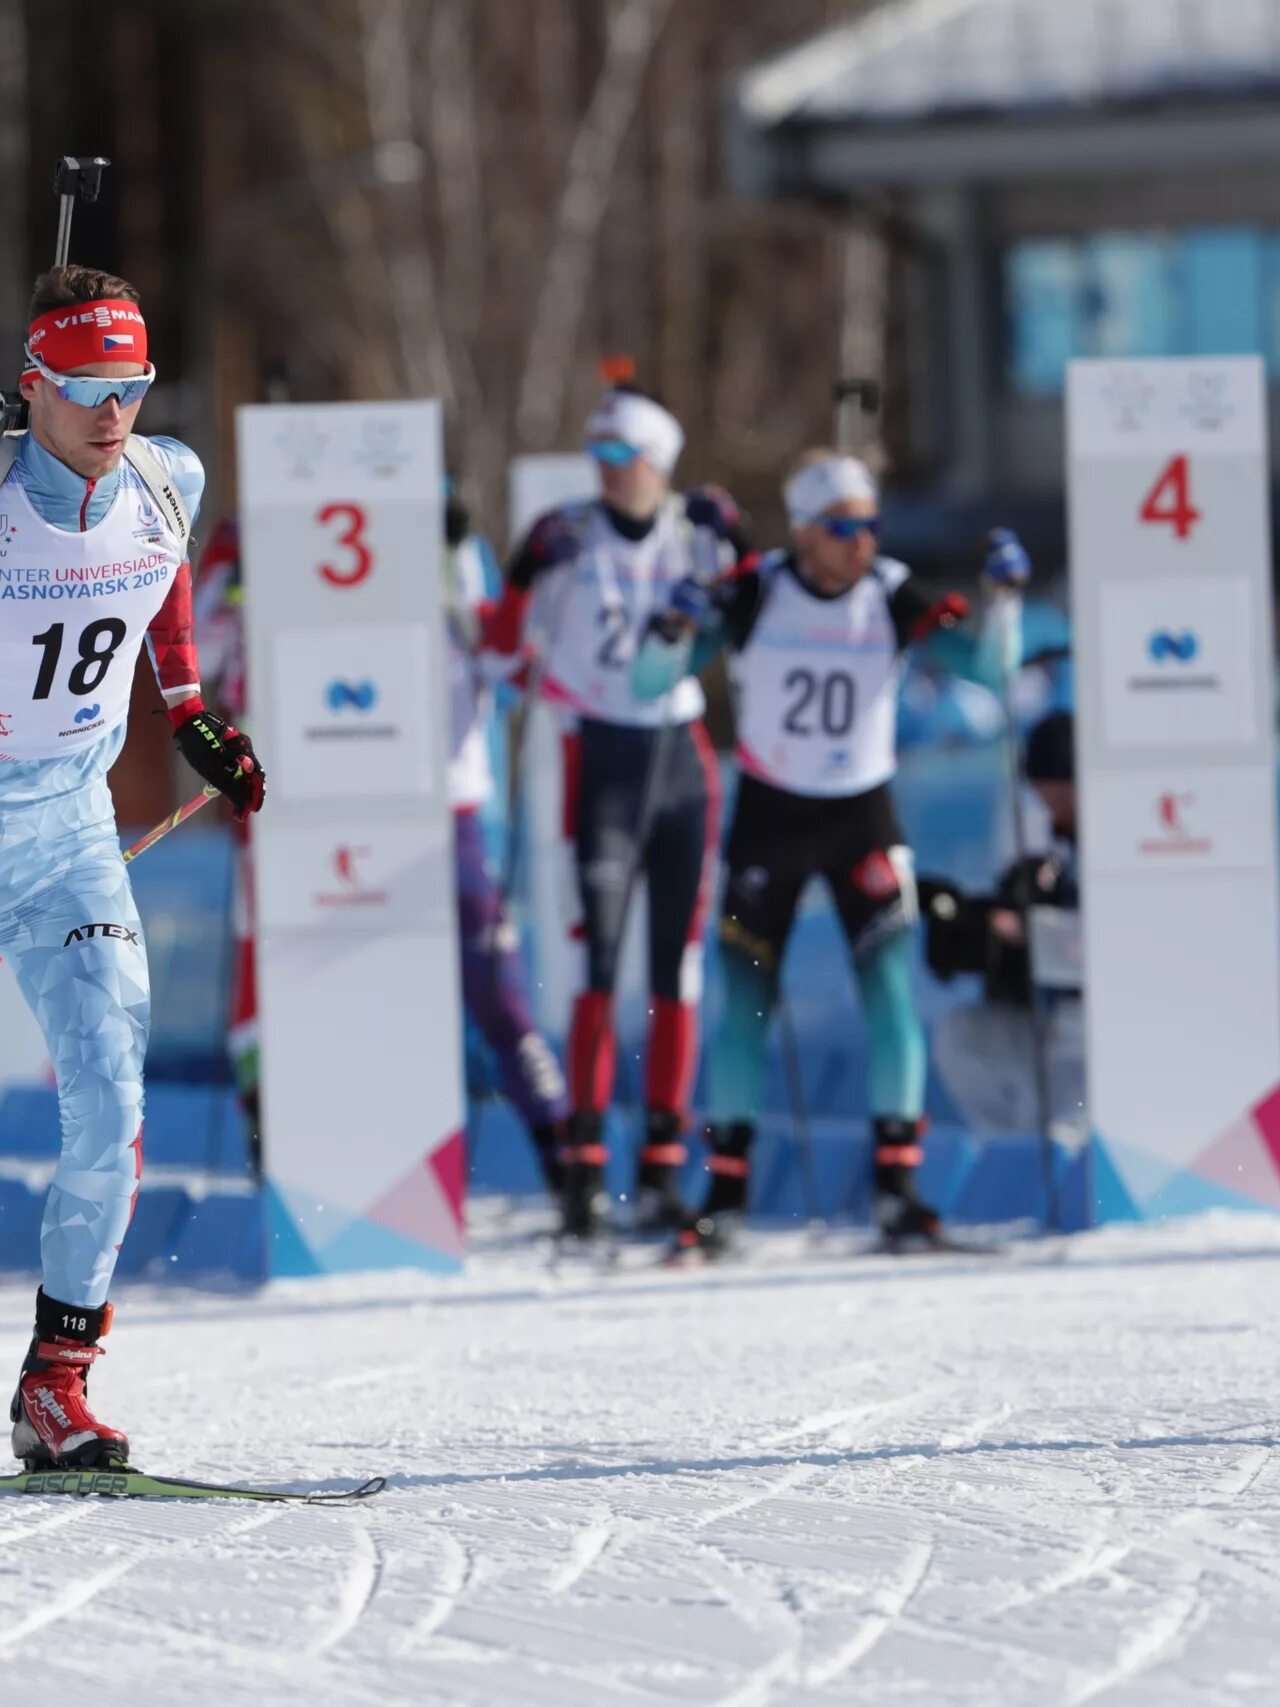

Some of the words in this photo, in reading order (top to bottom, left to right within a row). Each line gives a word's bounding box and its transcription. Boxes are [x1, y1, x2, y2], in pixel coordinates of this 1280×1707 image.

[1138, 452, 1200, 541] 4
[316, 501, 375, 588] 3
[55, 552, 168, 582] UNIVERSIADE
[133, 565, 169, 590] 2019
[31, 616, 128, 700] 18
[782, 667, 856, 737] 20
[58, 719, 106, 737] NORNICKEL
[192, 718, 220, 750] LEKI
[63, 923, 138, 947] ATEX
[61, 1314, 87, 1331] 118
[58, 1349, 93, 1359] alpina
[34, 1386, 72, 1429] alpina
[23, 1472, 129, 1494] FISCHER
